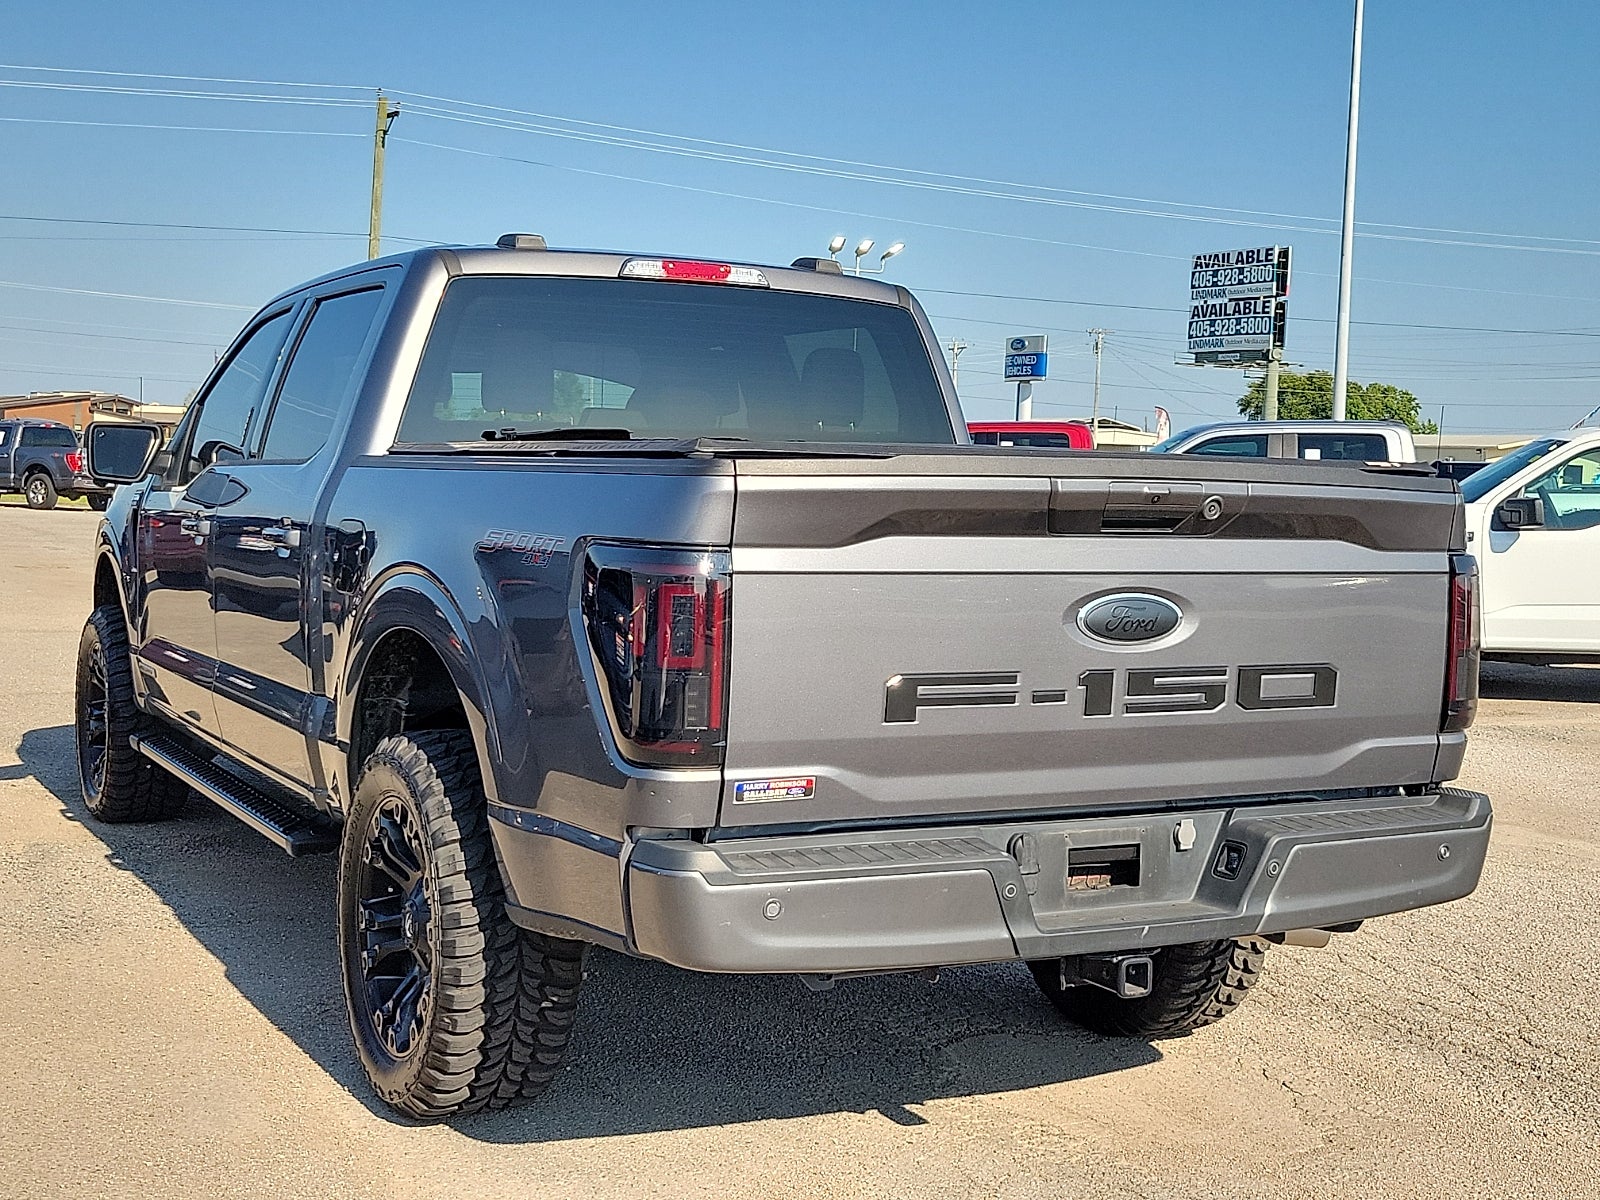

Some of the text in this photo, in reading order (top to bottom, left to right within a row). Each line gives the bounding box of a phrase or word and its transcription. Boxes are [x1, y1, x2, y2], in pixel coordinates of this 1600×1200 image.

[1193, 248, 1274, 270] AVAILABLE
[1192, 265, 1273, 287] 405-928-5800
[1191, 288, 1227, 300] LINDMARK
[1191, 300, 1270, 320] AVAILABLE
[1189, 317, 1270, 337] 405-928-5800
[1188, 338, 1225, 350] LINDMARK
[476, 528, 566, 556] SPORT
[1105, 606, 1160, 632] Ford
[883, 663, 1339, 725] F-150
[743, 780, 807, 791] HARRY ROBINSON
